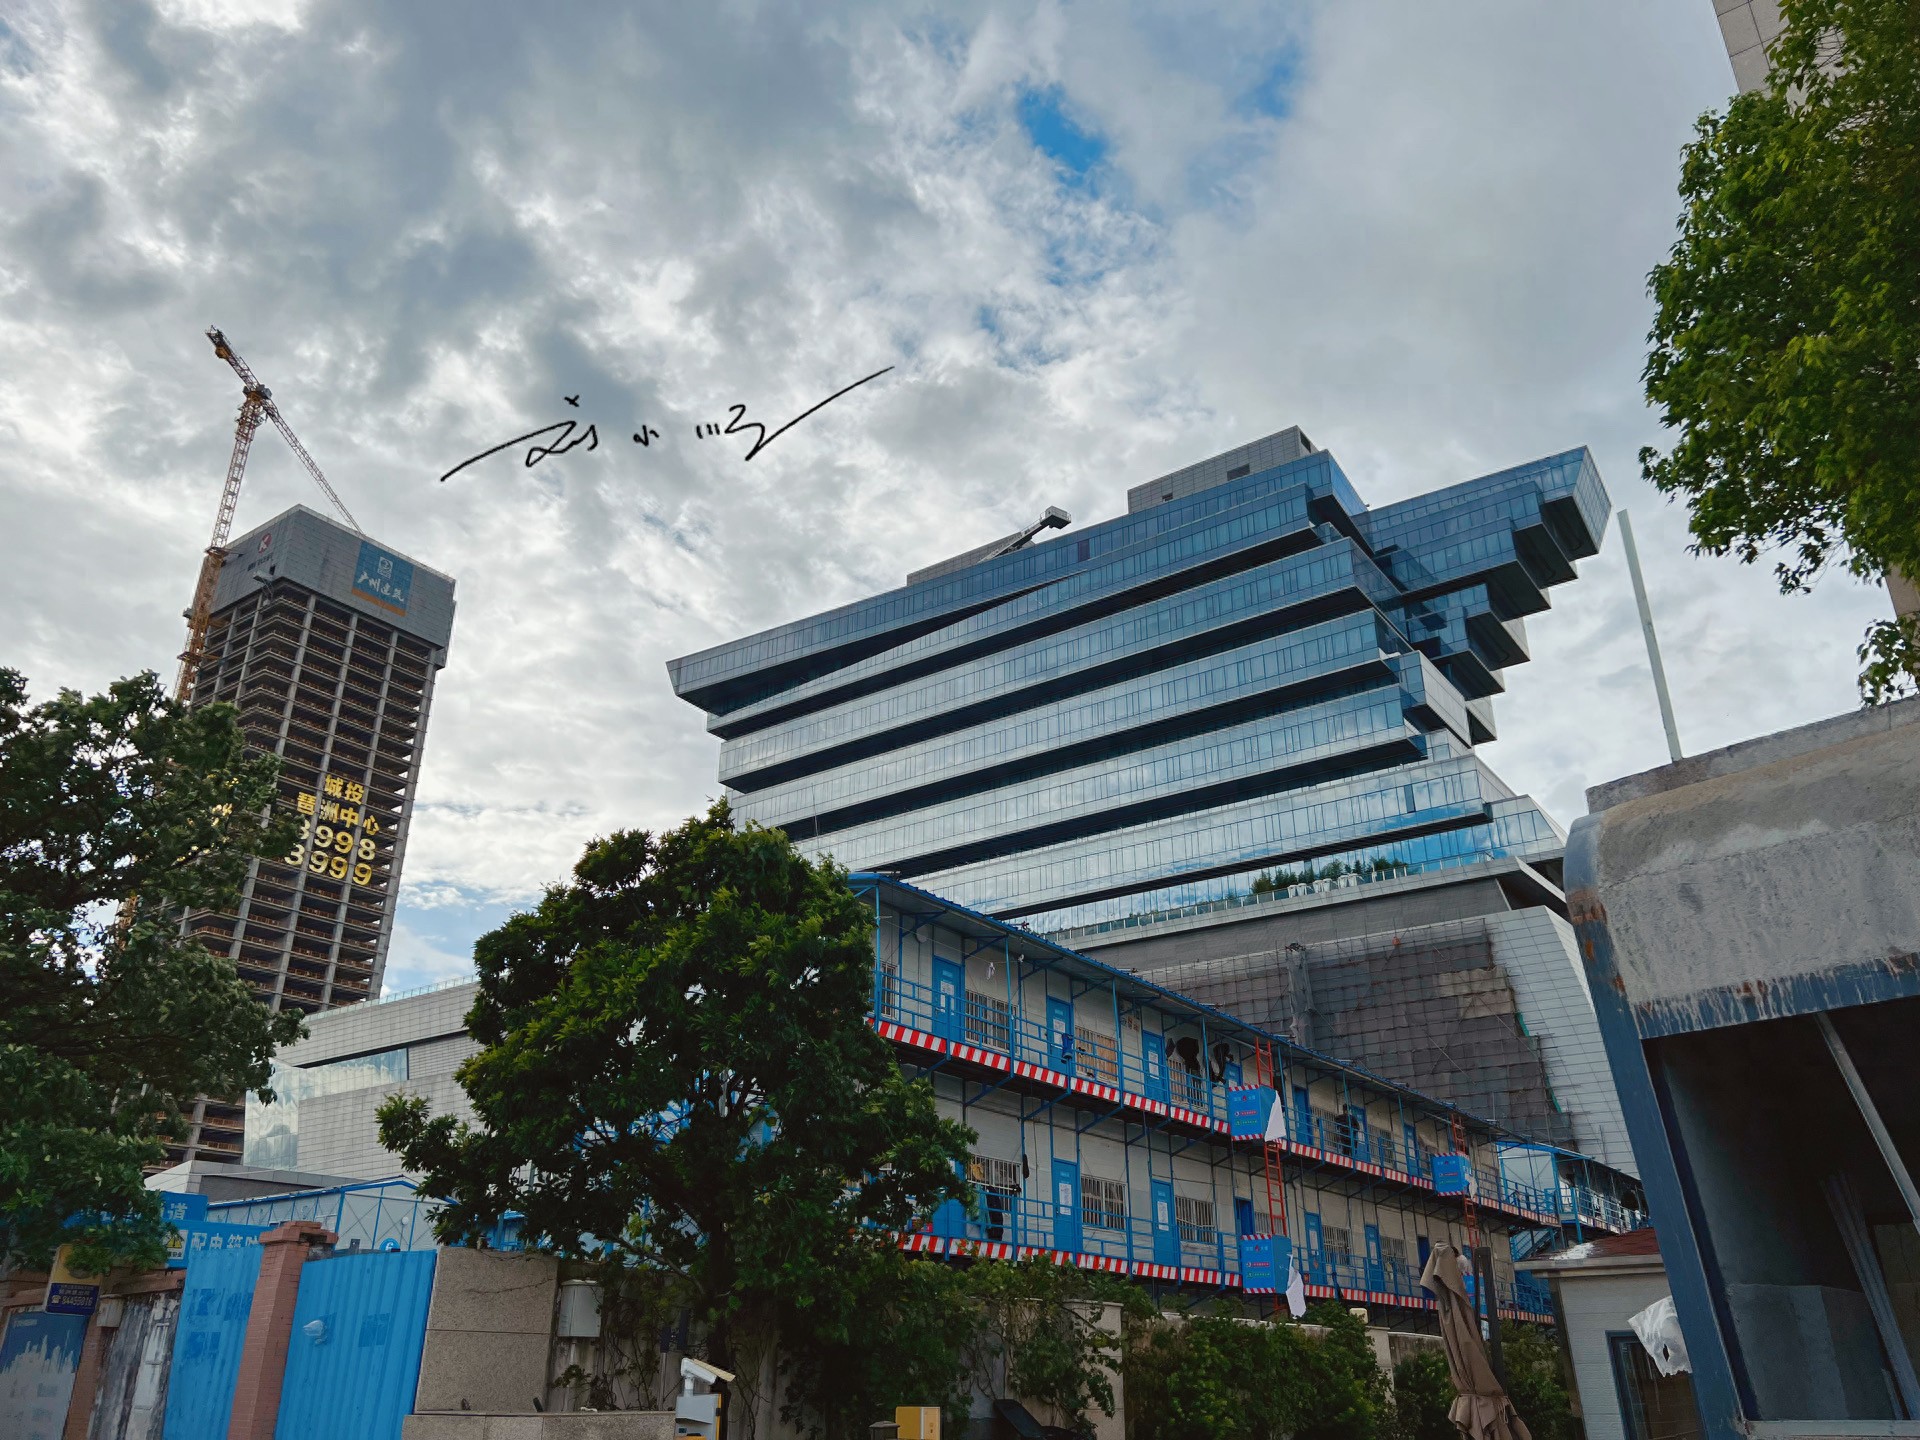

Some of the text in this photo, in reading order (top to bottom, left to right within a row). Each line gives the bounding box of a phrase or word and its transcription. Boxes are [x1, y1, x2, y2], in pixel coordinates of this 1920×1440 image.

[357, 571, 404, 602] 广州建筑
[324, 774, 364, 805] 城投
[296, 792, 380, 836] 琶洲中心
[298, 819, 376, 861] 3998
[284, 843, 373, 886] 3999
